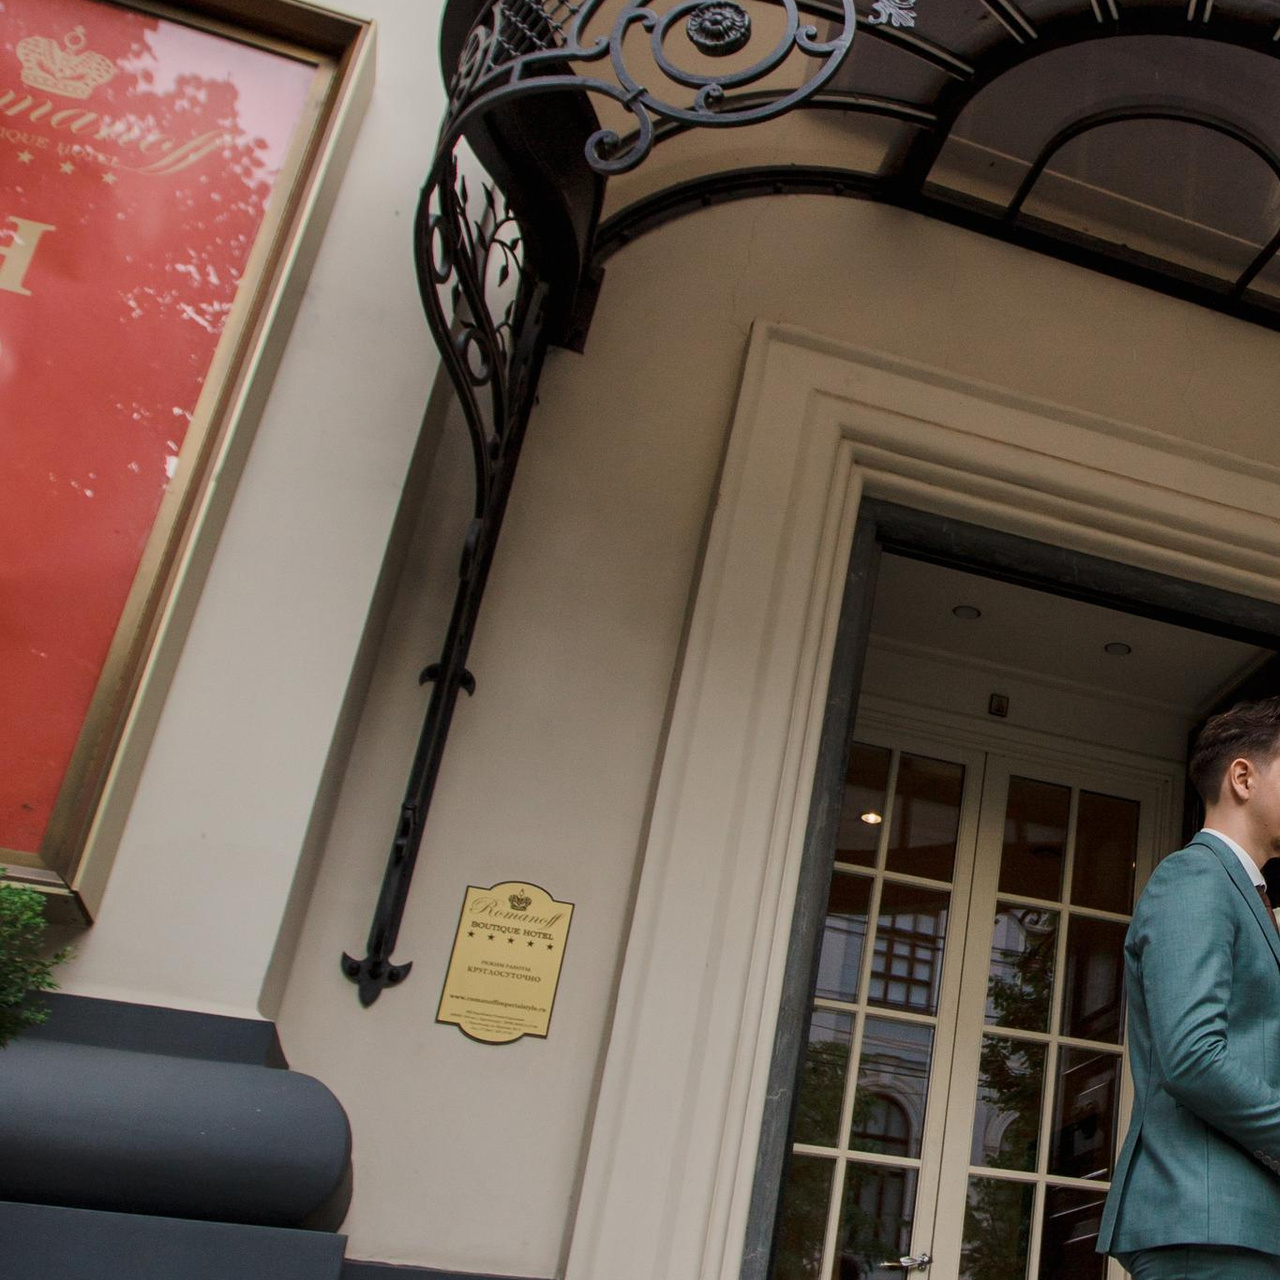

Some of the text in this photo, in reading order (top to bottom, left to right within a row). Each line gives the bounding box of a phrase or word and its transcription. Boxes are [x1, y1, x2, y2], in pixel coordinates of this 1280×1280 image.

[469, 896, 563, 931] Romanoff
[471, 920, 554, 941] BOUTIQUE HOTEL
[467, 965, 541, 982] КРУГЛОСУТОЧНО
